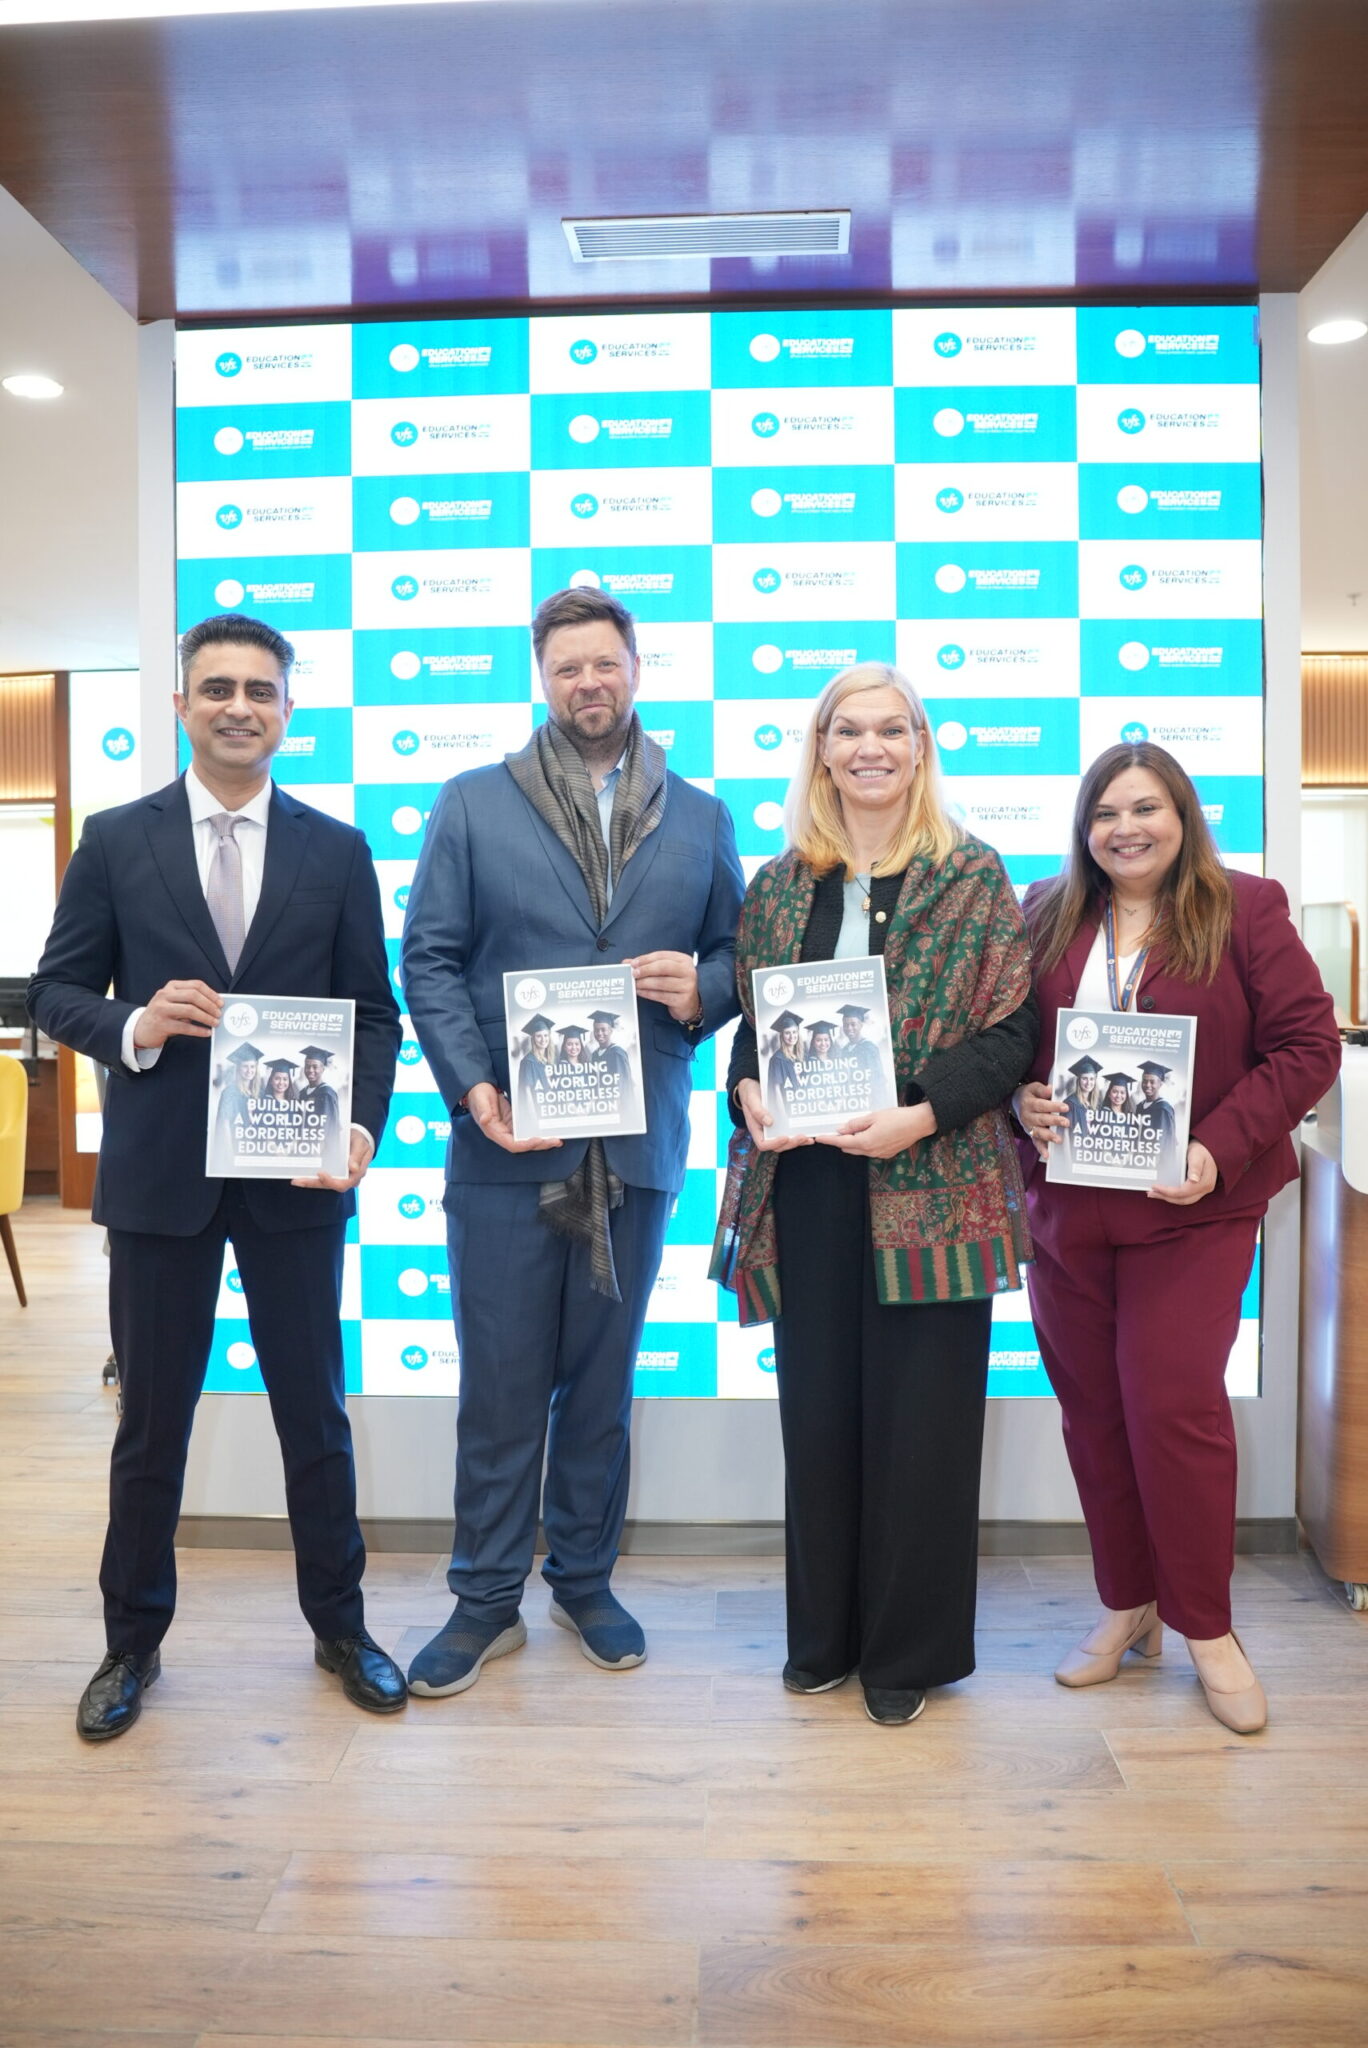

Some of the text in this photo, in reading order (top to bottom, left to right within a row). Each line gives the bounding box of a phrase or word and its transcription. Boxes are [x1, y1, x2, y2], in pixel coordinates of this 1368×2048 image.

[602, 343, 658, 351] EDUCATION
[974, 343, 1022, 351] SERVICES
[610, 350, 657, 358] SERVICES
[1150, 412, 1207, 420] EDUCATION
[1158, 419, 1206, 427] SERVICES
[791, 424, 839, 432] SERVICES
[430, 433, 476, 441] SERVICES
[602, 497, 658, 505] EDUCATION
[975, 499, 1023, 507] SERVICES
[246, 508, 301, 516] EDUCATION
[610, 504, 657, 512] SERVICES
[254, 515, 300, 523] SERVICES
[422, 579, 477, 587] EDUCATION
[793, 579, 840, 587] SERVICES
[1160, 576, 1208, 584] SERVICES
[430, 586, 476, 594] SERVICES
[969, 648, 1026, 656] EDUCATION
[977, 656, 1025, 664] SERVICES
[1154, 724, 1211, 733] EDUCATION
[423, 734, 479, 742] EDUCATION
[1162, 732, 1210, 740] SERVICES
[431, 742, 478, 750] SERVICES
[971, 807, 1028, 815] EDUCATION
[979, 814, 1027, 822] SERVICES
[797, 972, 860, 986] EDUCATION
[549, 979, 611, 991] EDUCATION
[806, 982, 858, 993] SERVICES
[558, 988, 609, 999] SERVICES
[262, 1011, 328, 1021] EDUCATION
[270, 1020, 326, 1031] SERVICES
[1103, 1026, 1167, 1038] EDUCATION
[1109, 1036, 1164, 1046] SERVICES
[545, 1061, 607, 1076] BUILDING
[794, 1057, 858, 1073] BUILDING
[535, 1074, 620, 1090] A WORLD OF
[784, 1070, 871, 1088] A WORLD OF
[537, 1087, 620, 1103] BORDERLESS
[786, 1084, 871, 1101] BORDERLESS
[248, 1098, 315, 1112] BUILDING
[541, 1101, 617, 1116] EDUCATION
[791, 1099, 870, 1114] EDUCATION
[234, 1114, 327, 1126] A WORLD OF
[1086, 1110, 1151, 1125] BUILDING
[235, 1127, 325, 1140] BORDERLESS
[1073, 1125, 1163, 1140] A WORLD OF
[238, 1142, 321, 1154] EDUCATION
[1074, 1136, 1160, 1153] BORDERLESS
[1076, 1150, 1156, 1166] EDUCATION
